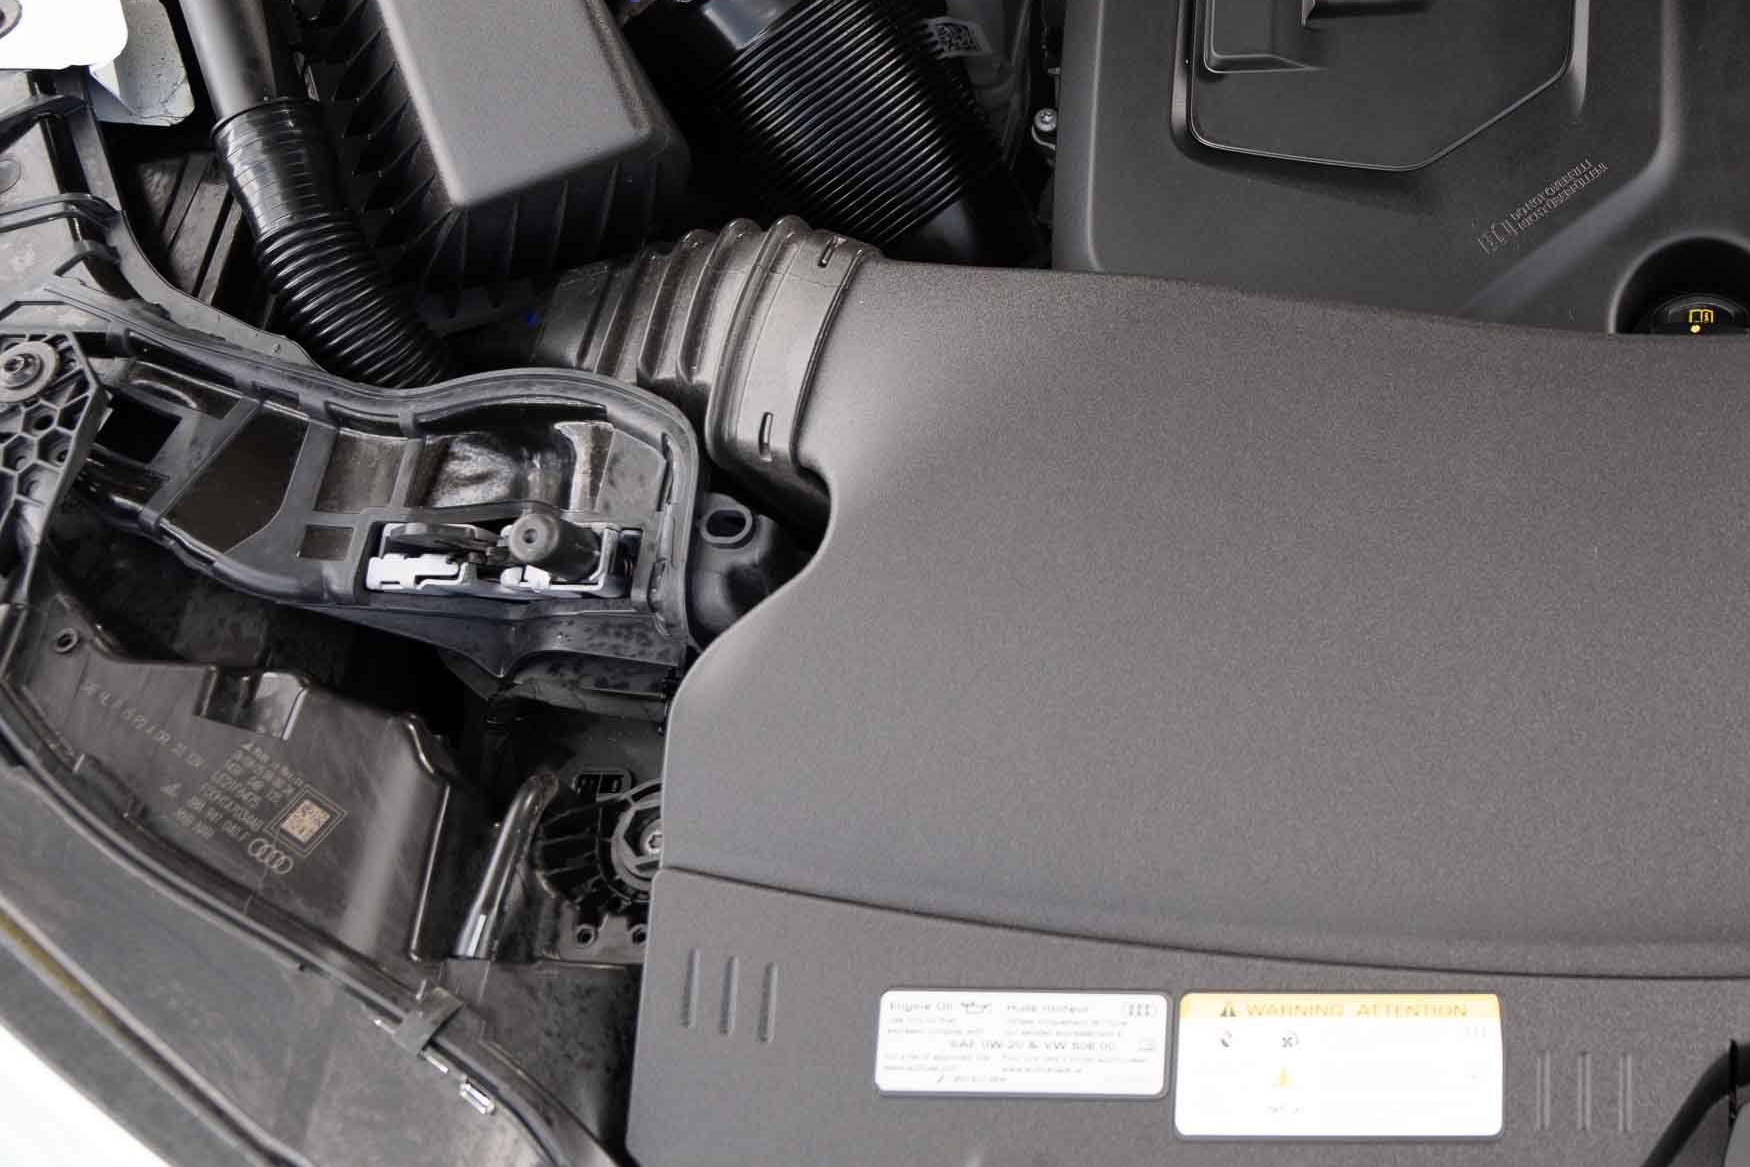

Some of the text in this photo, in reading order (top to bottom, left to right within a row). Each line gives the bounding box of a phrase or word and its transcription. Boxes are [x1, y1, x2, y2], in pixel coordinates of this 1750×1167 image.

[1247, 1003, 1468, 1017] WARNING ATTENTION
[949, 1040, 975, 1050] SAE
[1044, 1041, 1066, 1050] VW
